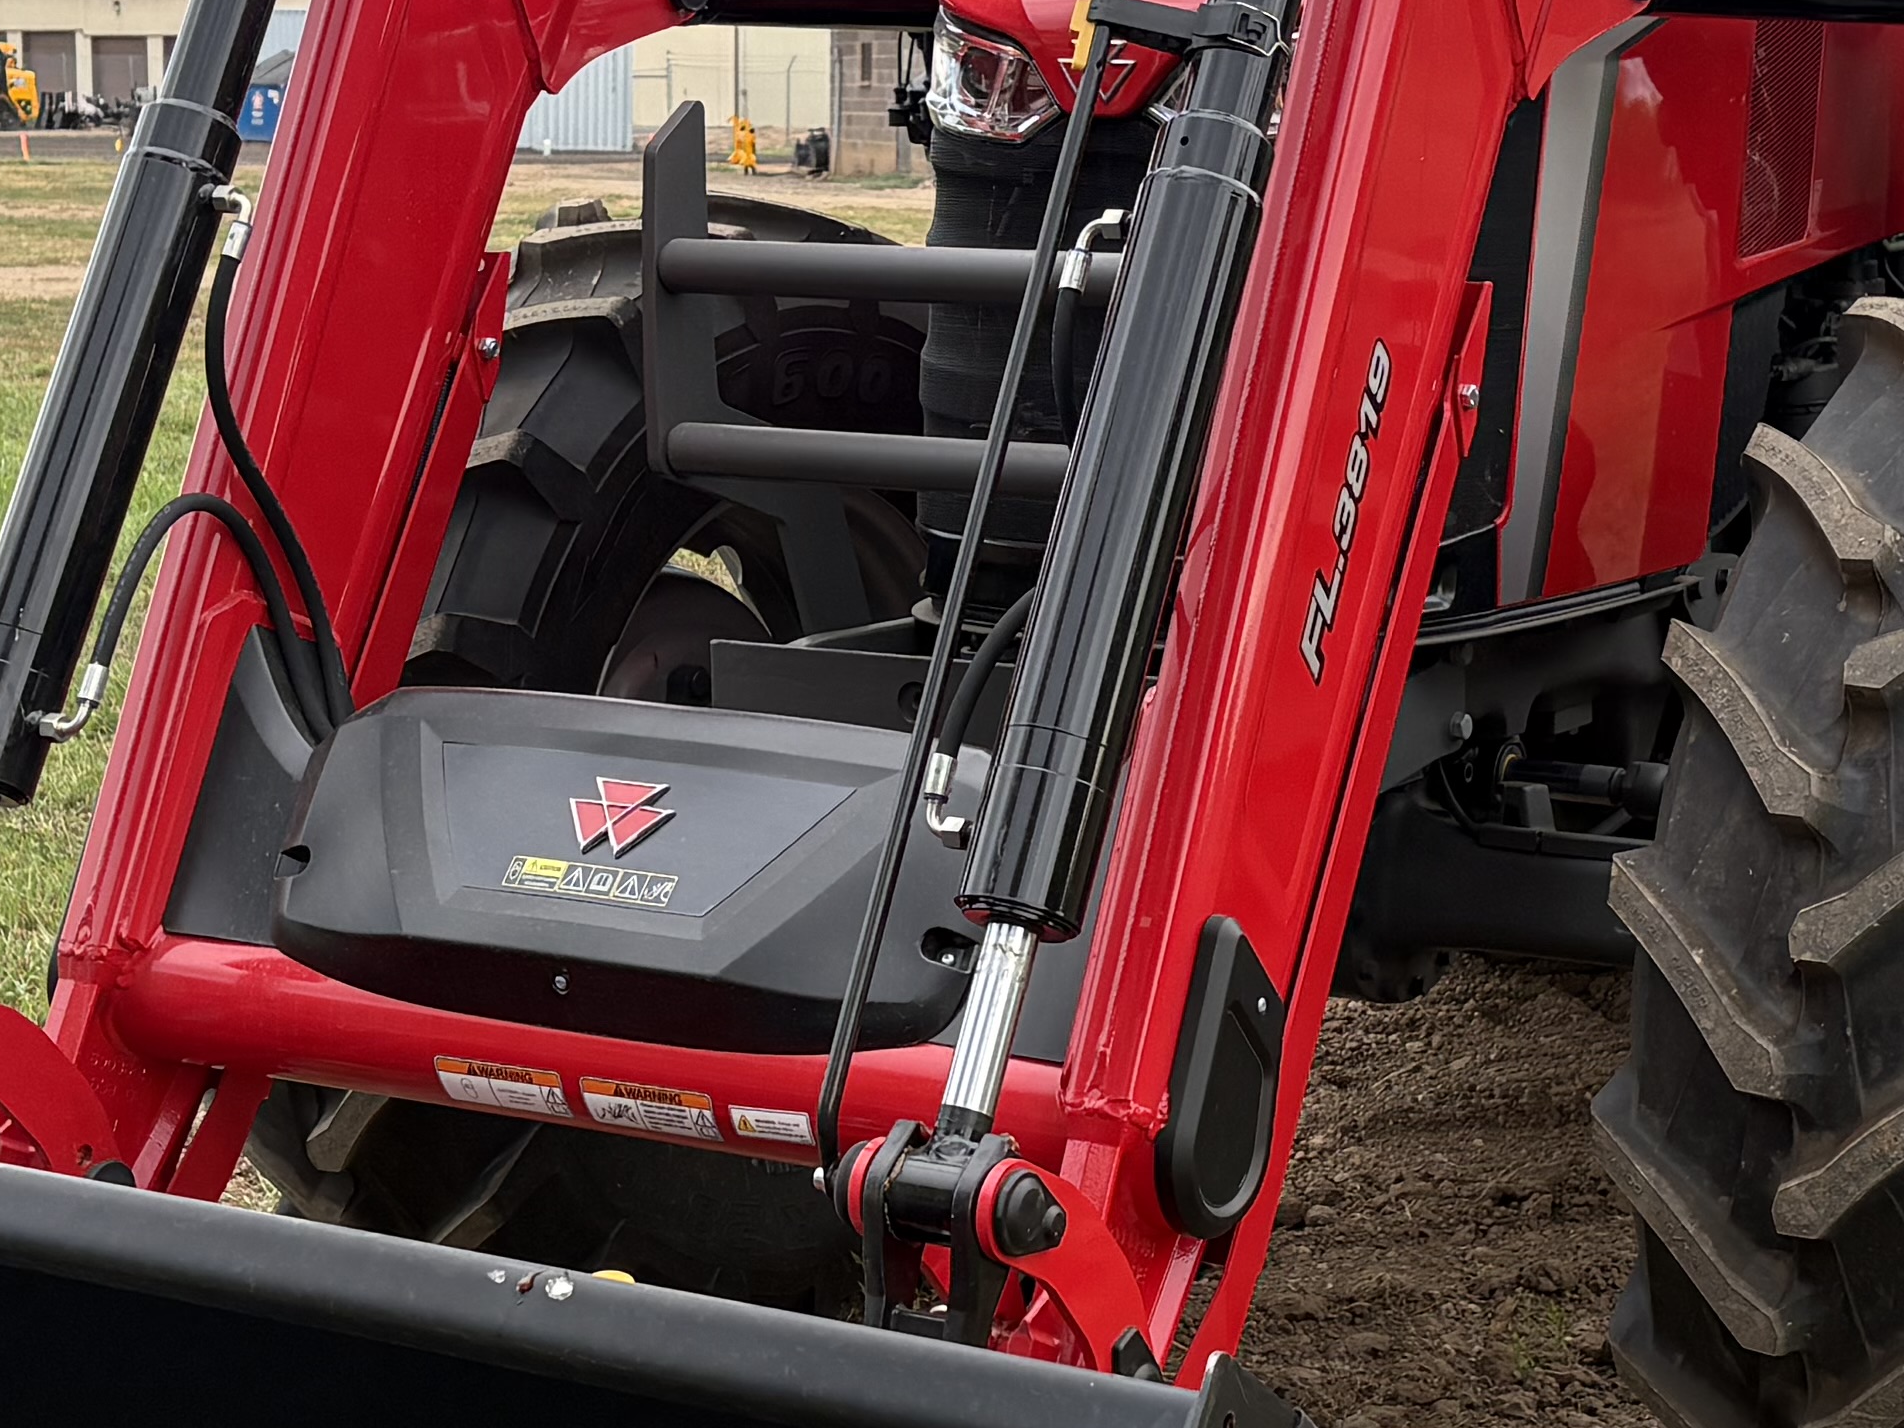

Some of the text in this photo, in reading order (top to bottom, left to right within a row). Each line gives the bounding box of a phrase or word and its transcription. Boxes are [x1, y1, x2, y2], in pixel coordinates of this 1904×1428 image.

[770, 345, 893, 406] 600
[1299, 335, 1393, 687] FL.3819
[478, 1063, 534, 1085] WARNING
[625, 1086, 683, 1106] WARNING
